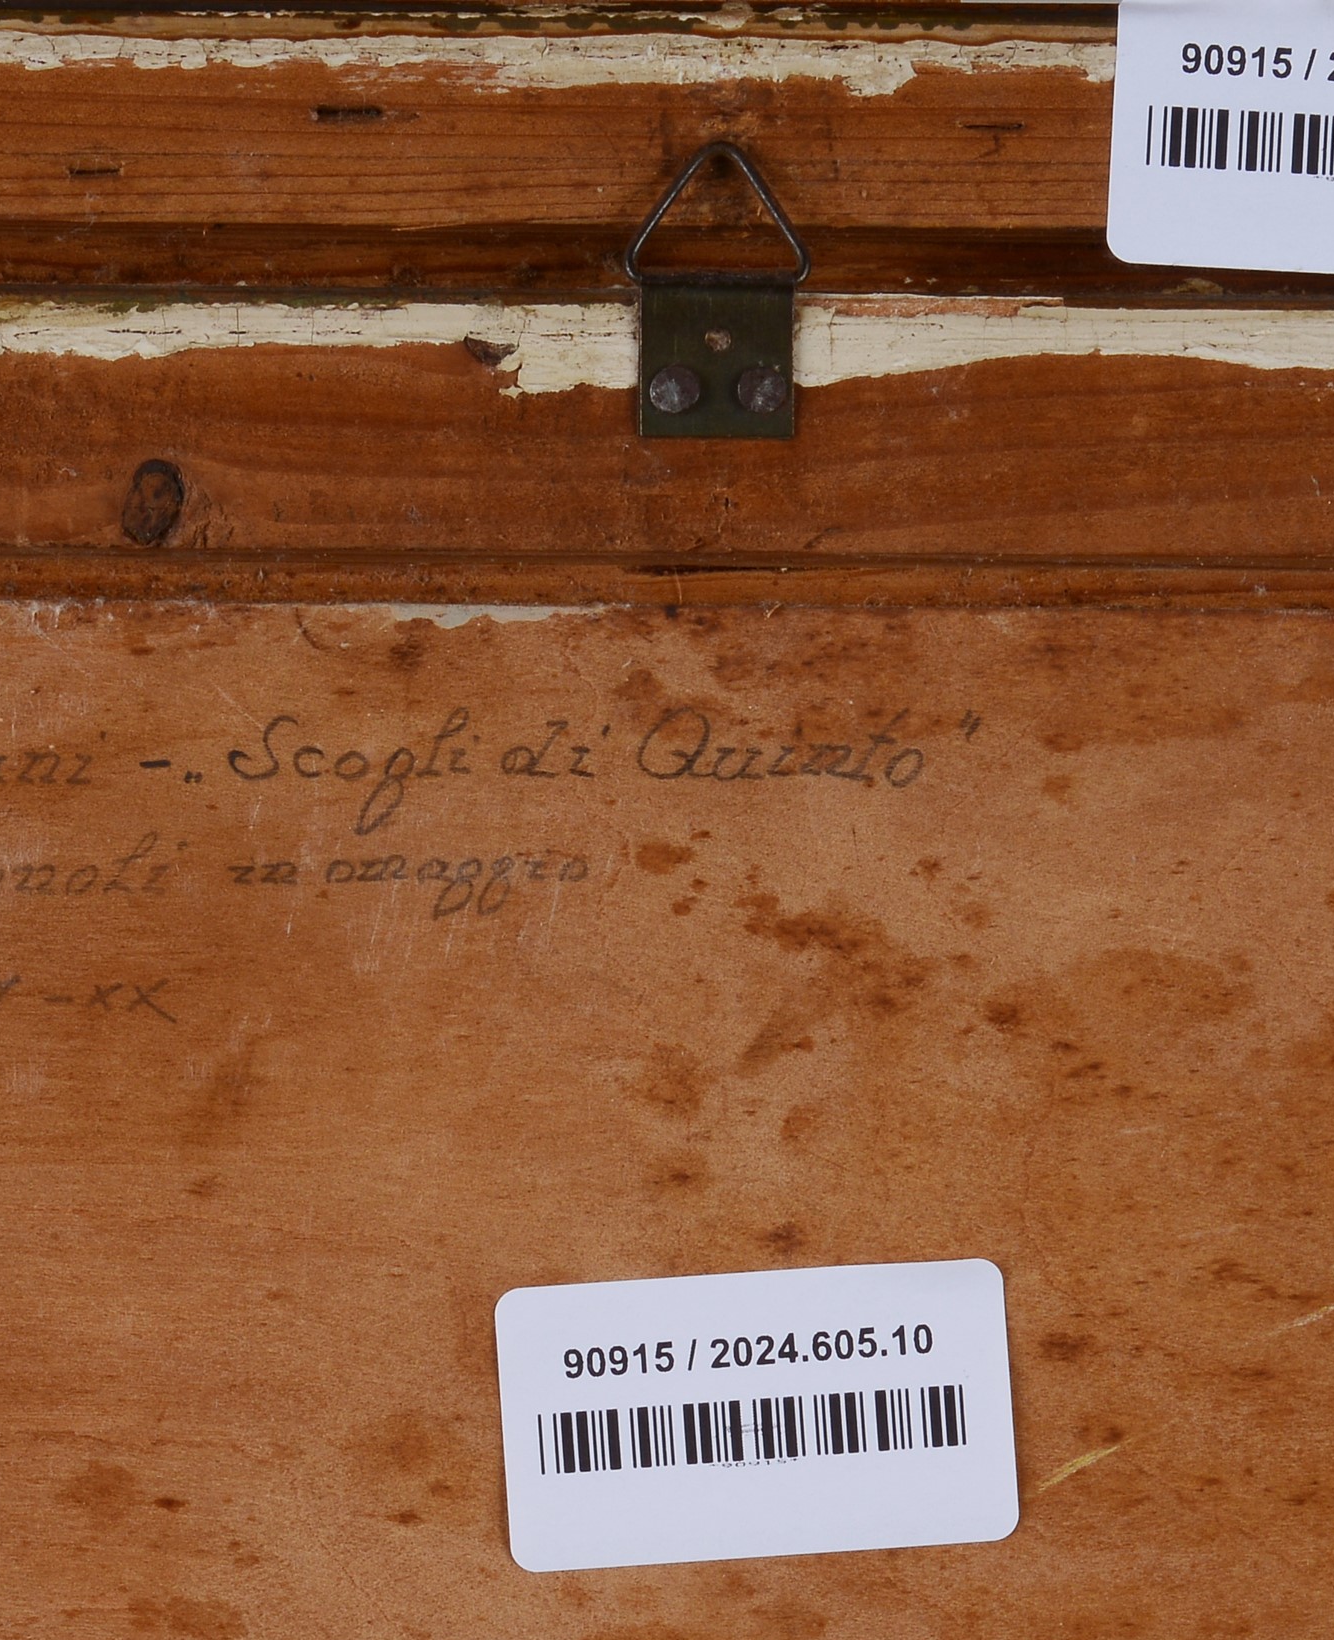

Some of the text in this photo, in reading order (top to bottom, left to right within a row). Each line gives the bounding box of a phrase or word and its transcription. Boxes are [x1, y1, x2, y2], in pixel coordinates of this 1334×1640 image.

[1181, 42, 1293, 80] 90915
[1304, 48, 1318, 81] /
[499, 718, 611, 779] di
[563, 1323, 935, 1379] 90915 / 2024.605.10
